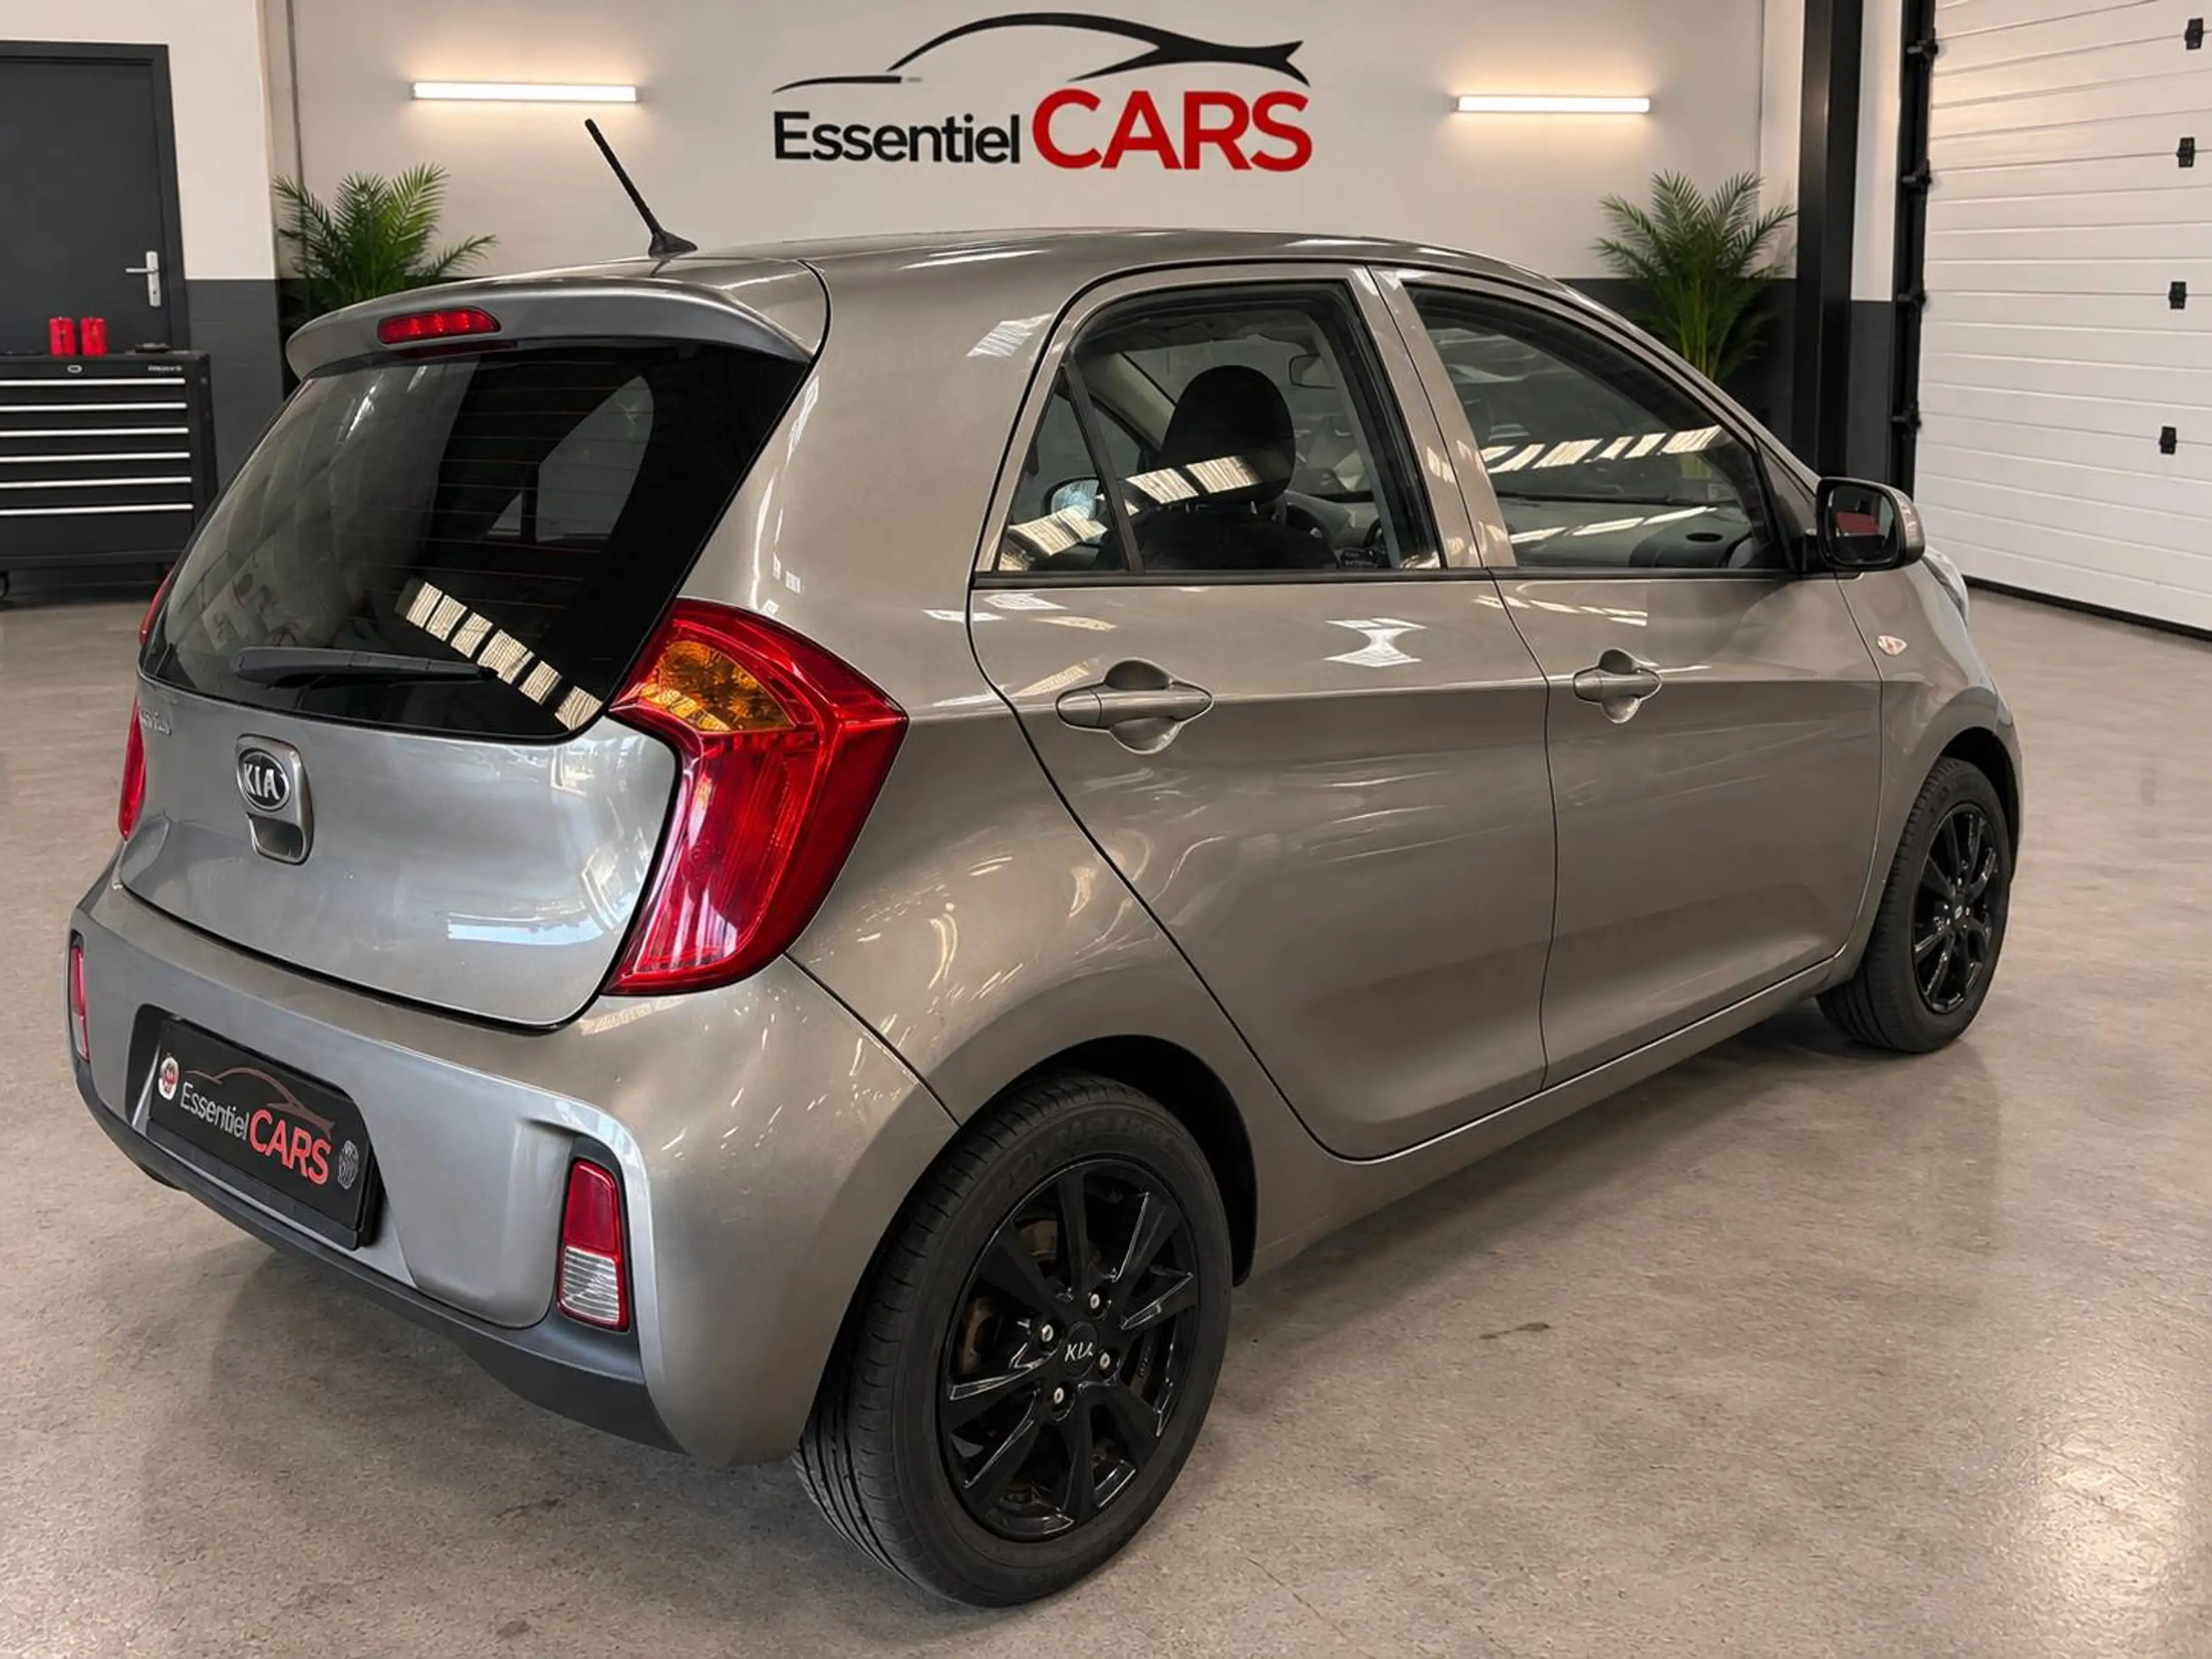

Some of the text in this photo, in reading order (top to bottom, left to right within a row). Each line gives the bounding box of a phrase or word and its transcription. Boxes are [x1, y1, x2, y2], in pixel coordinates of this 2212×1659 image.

[774, 88, 1313, 172] Essentiel CARS
[244, 763, 280, 800] KIA
[180, 1081, 331, 1185] Essentiel CARS
